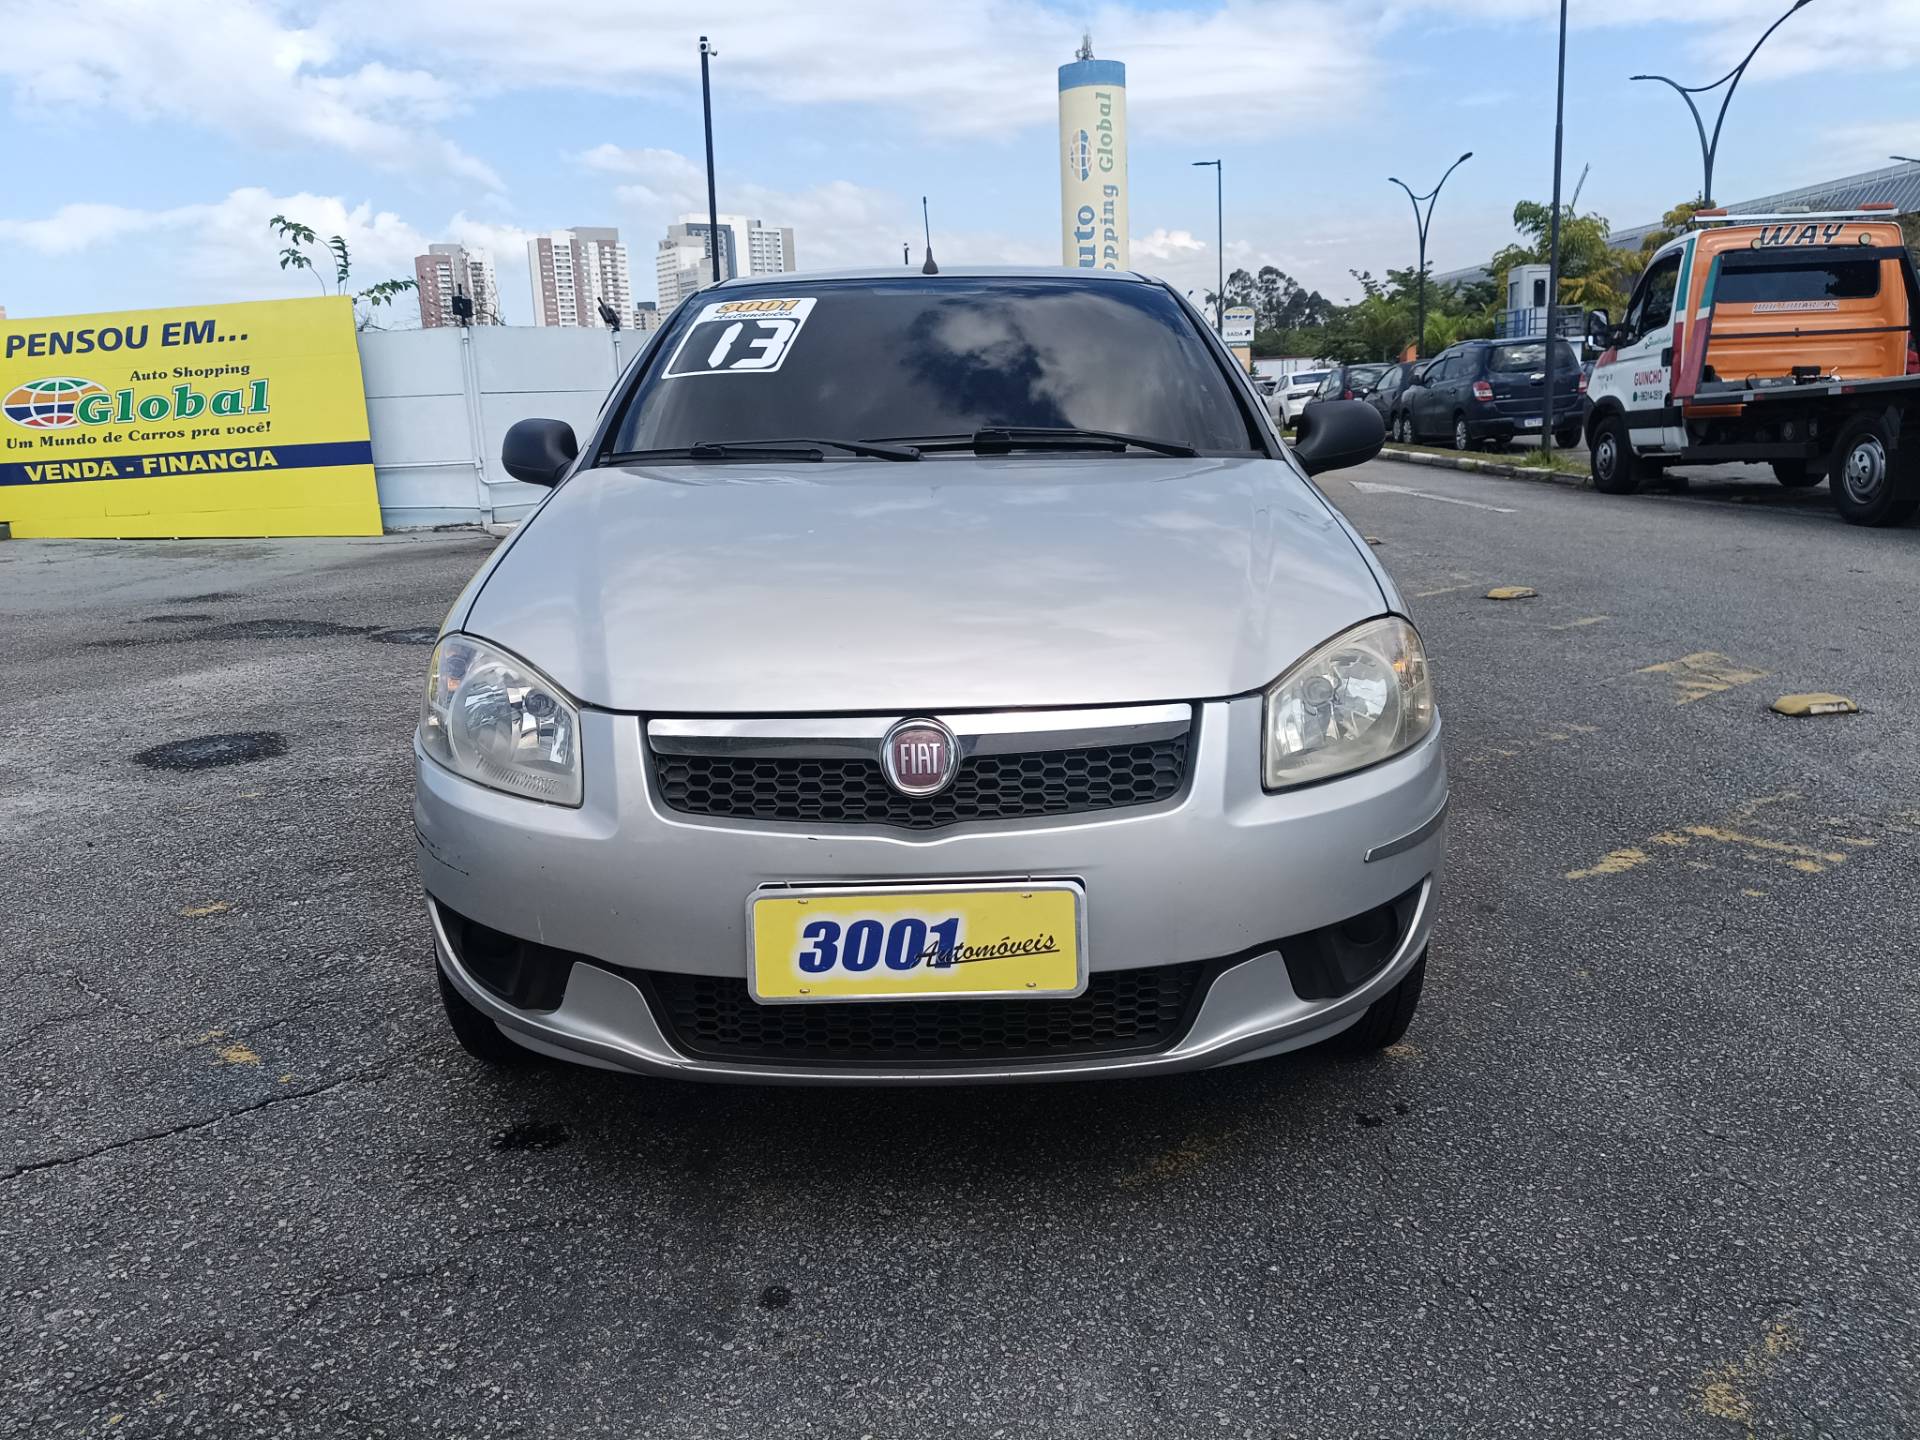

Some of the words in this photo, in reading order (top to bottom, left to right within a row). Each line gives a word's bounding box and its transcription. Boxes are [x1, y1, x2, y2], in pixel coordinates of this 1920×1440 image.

[1096, 91, 1114, 173] Global
[1760, 223, 1844, 247] WAY
[715, 300, 800, 313] 3001
[5, 324, 149, 358] PENSOU
[161, 319, 249, 347] EM...
[707, 319, 797, 369] 13
[130, 370, 168, 382] Auto
[173, 364, 251, 379] Shopping
[1633, 368, 1662, 386] GUINCHO
[76, 378, 271, 427] Global
[6, 437, 34, 449] Um
[40, 433, 97, 447] Mundo
[103, 431, 122, 443] de
[128, 428, 186, 442] Carros
[191, 427, 220, 440] pra
[226, 421, 271, 435] você!
[24, 460, 119, 481] VENDA
[142, 450, 278, 475] FINANCIA
[900, 742, 941, 775] FIAT
[798, 917, 960, 974] 3001
[911, 933, 1058, 967] Automóveis
